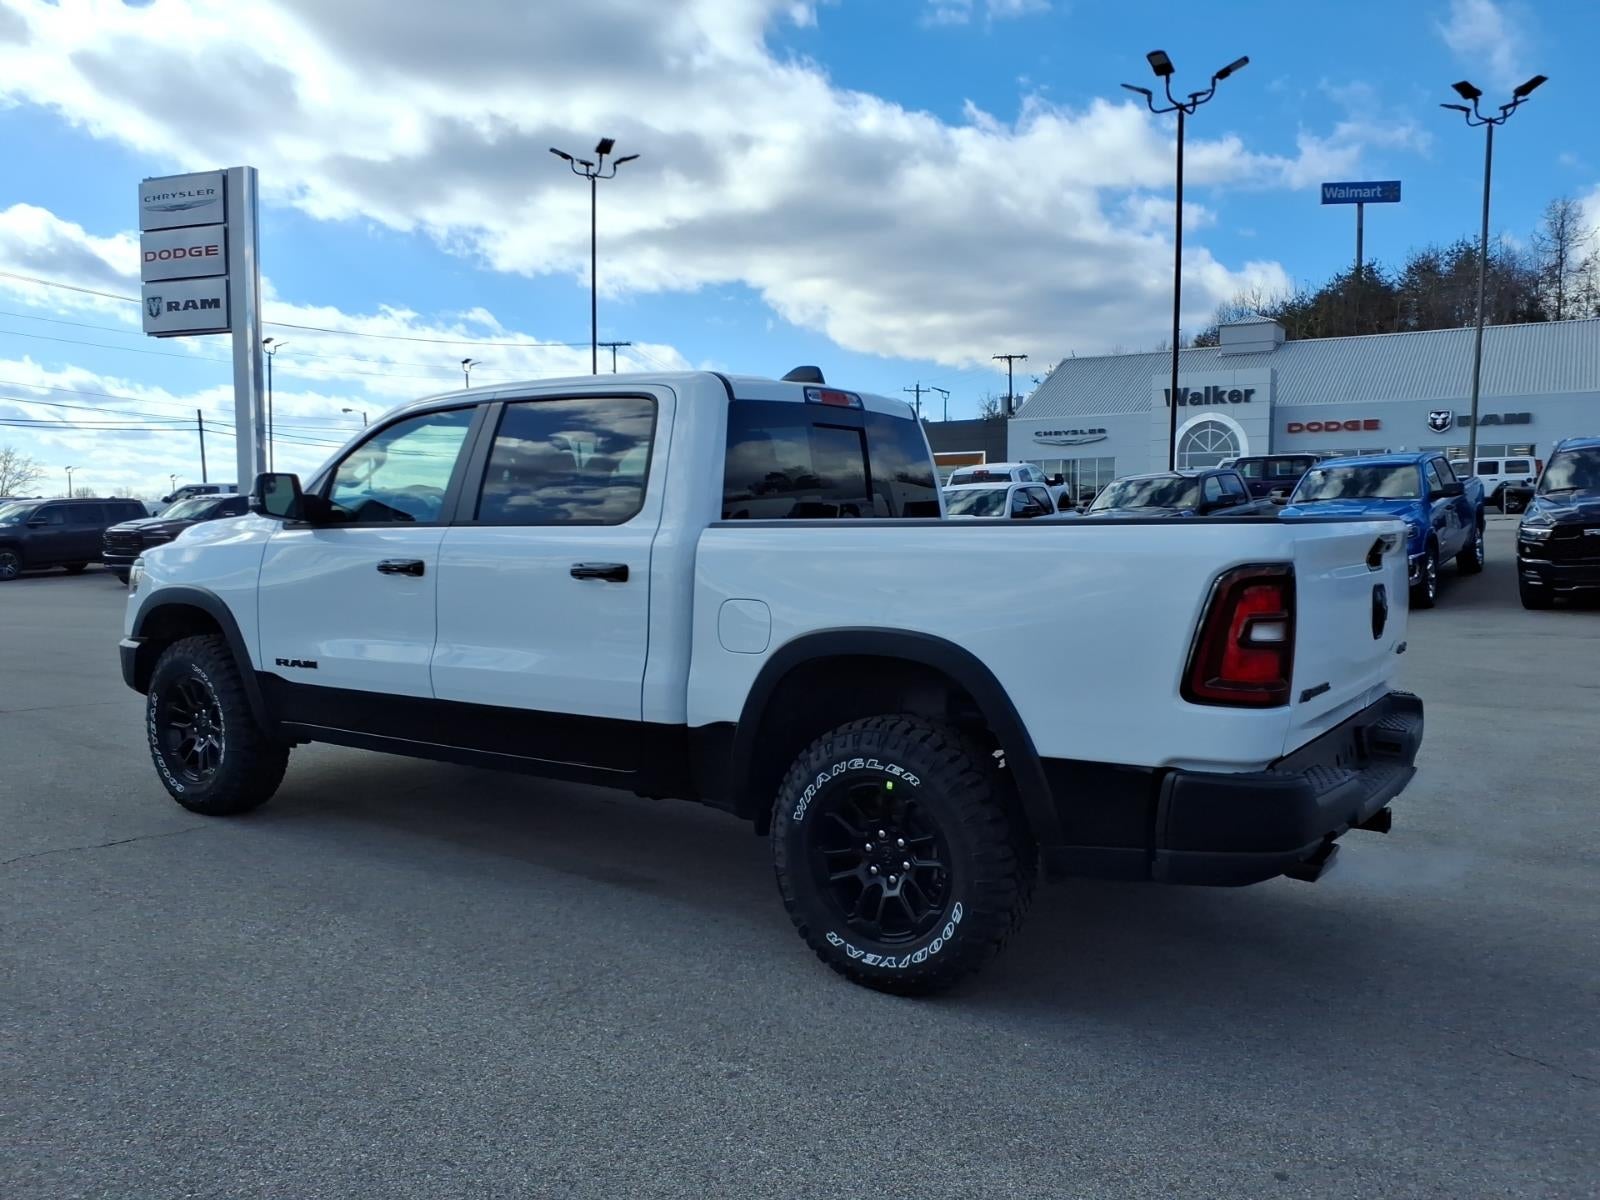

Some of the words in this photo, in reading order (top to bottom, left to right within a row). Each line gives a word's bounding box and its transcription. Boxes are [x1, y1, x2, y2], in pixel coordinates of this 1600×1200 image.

[143, 188, 215, 203] CHRYSLER
[1323, 185, 1382, 199] Walmart
[144, 244, 219, 263] DODGE
[166, 298, 221, 313] RAM
[1164, 385, 1255, 408] Walker
[1034, 428, 1107, 438] CHRYSLER
[1287, 419, 1380, 434] DODGE
[275, 658, 318, 670] RAM
[793, 758, 921, 822] WRANGLER
[825, 901, 964, 968] GOODYEAR
